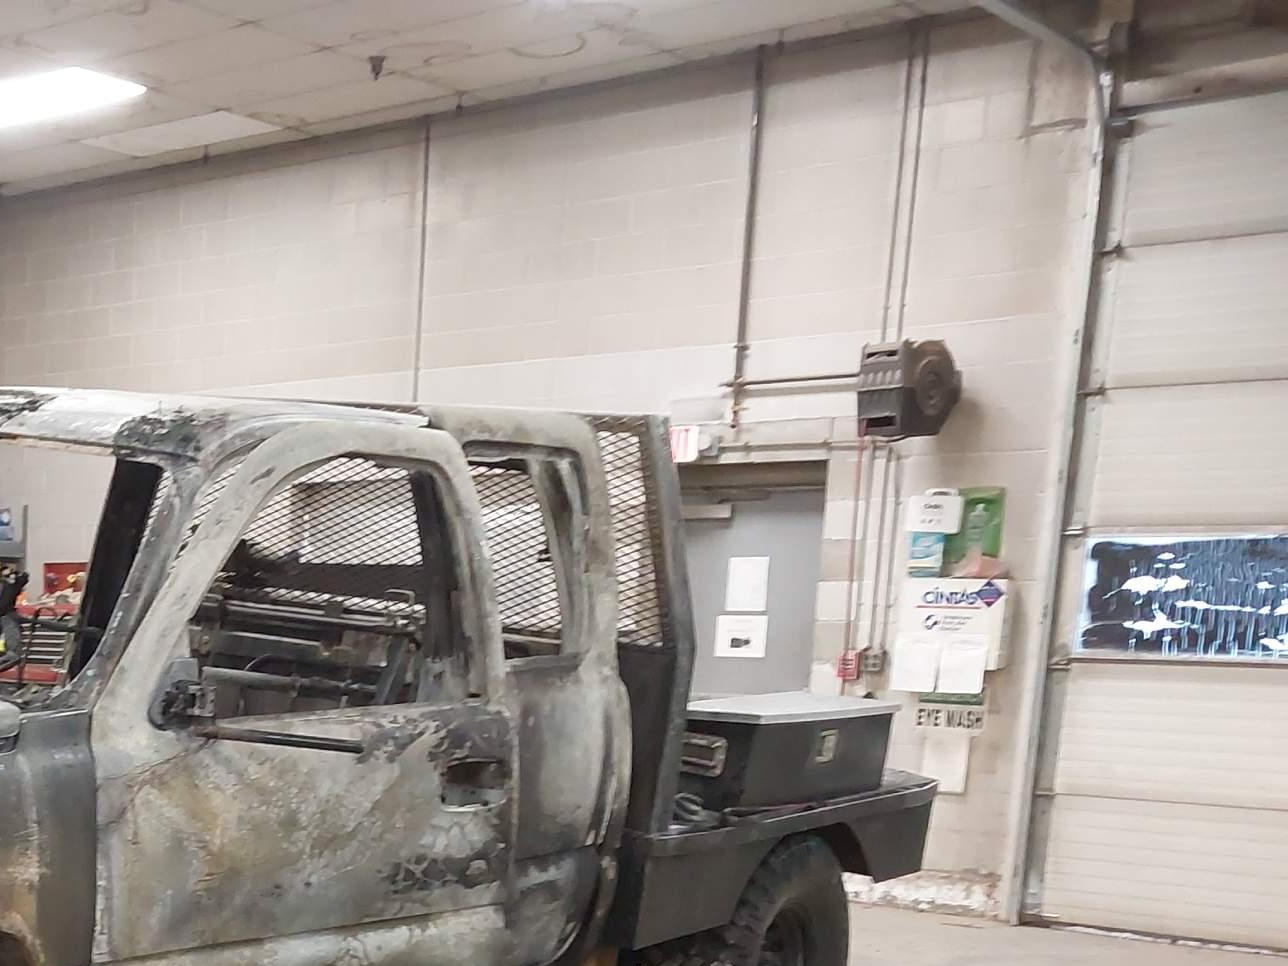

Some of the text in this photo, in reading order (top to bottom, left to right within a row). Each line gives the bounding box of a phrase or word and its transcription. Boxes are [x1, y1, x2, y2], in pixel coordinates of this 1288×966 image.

[922, 586, 979, 605] CINTAS
[916, 708, 984, 729] EYE WASH
